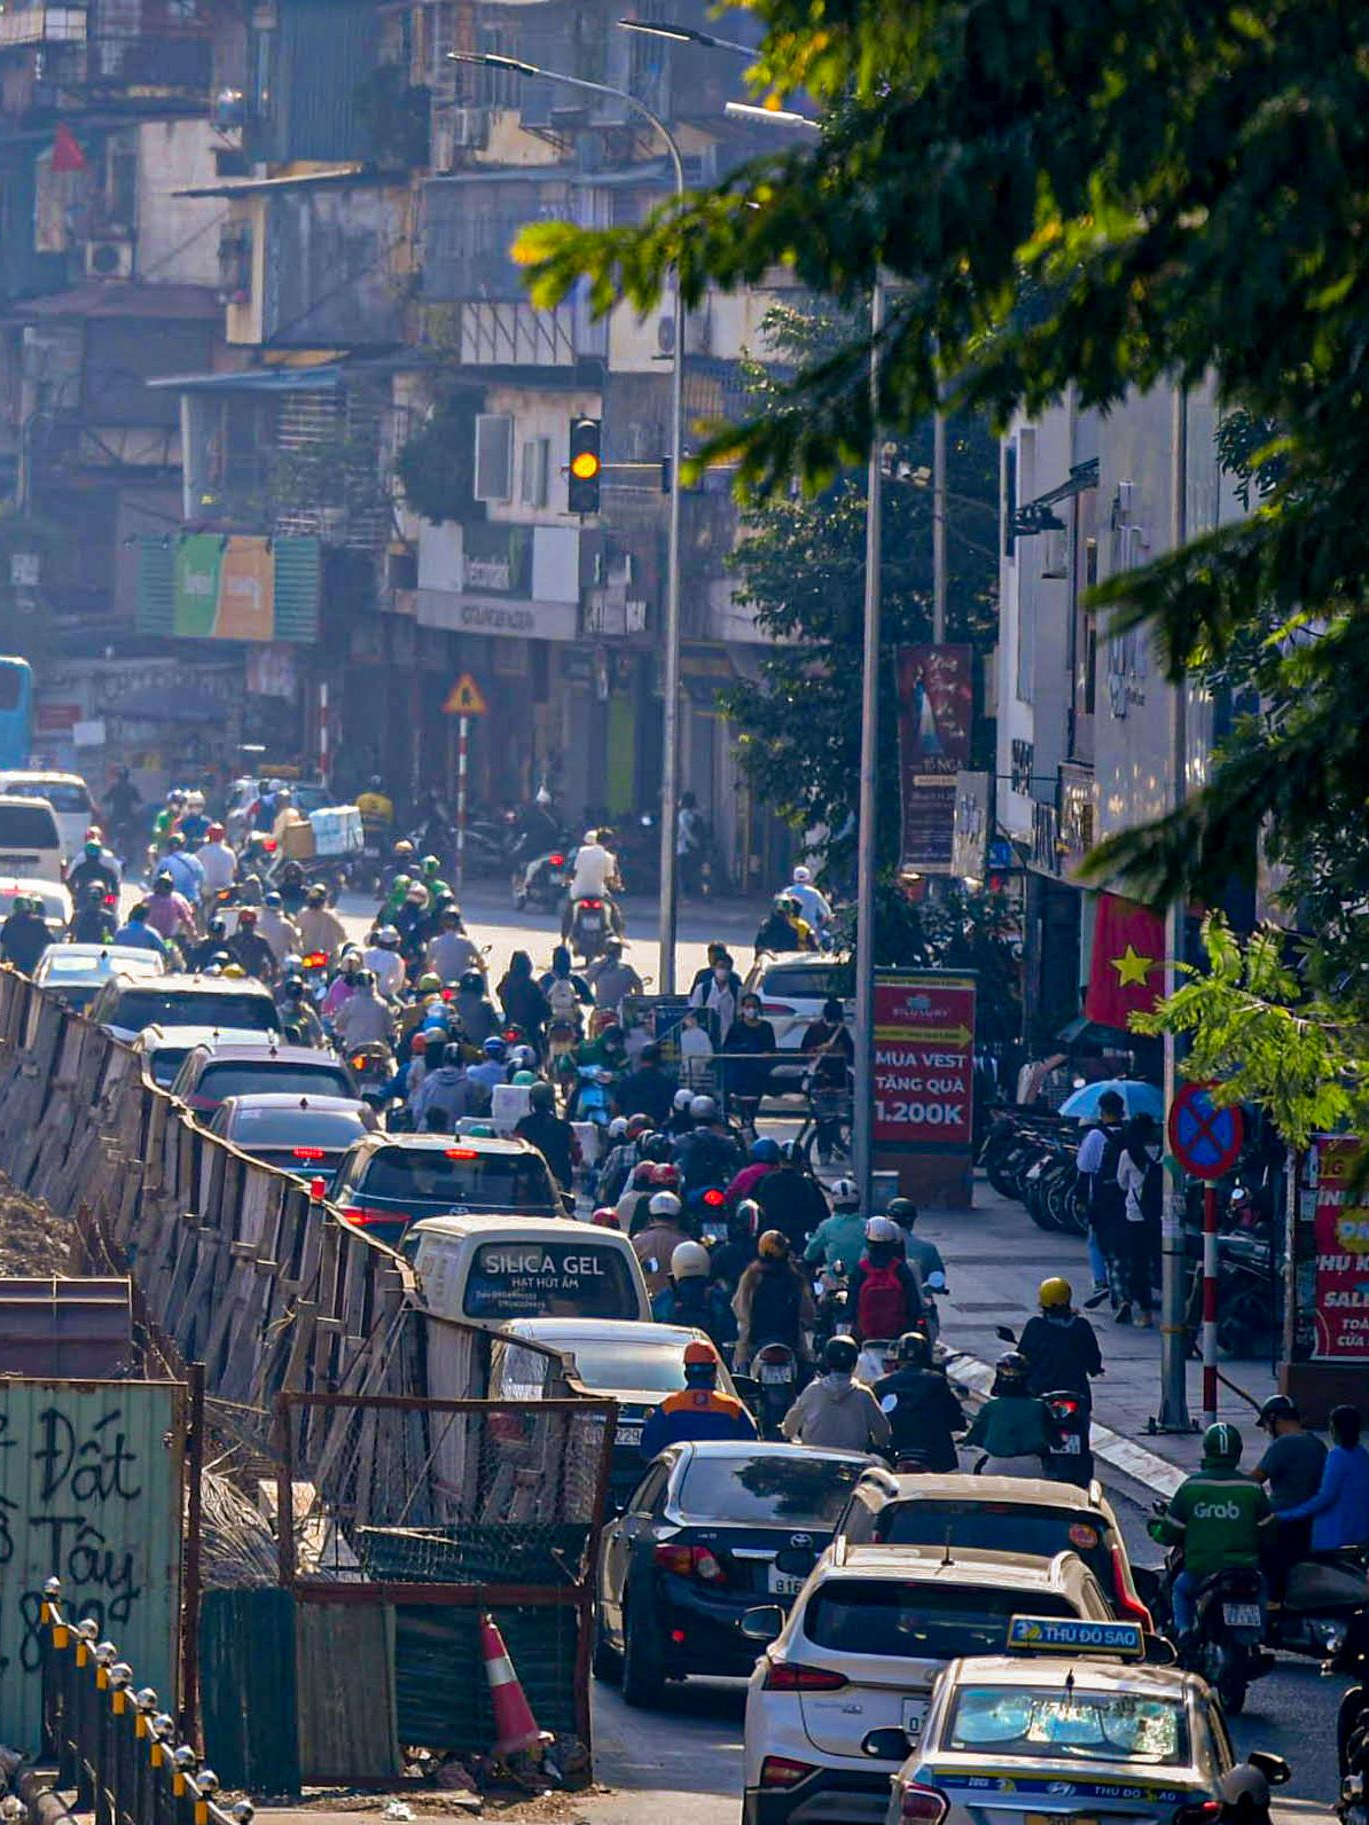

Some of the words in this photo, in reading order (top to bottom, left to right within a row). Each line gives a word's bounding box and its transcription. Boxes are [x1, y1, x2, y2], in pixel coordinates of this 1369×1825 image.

[875, 1051, 917, 1066] MUA
[921, 1053, 968, 1068] VEST
[875, 1074, 923, 1093] TẶNG
[926, 1076, 965, 1095] QUÀ
[874, 1101, 964, 1124] 1.200K
[485, 1254, 556, 1275] SILICA
[562, 1255, 605, 1276] GEL
[1316, 1254, 1351, 1276] HỤ
[33, 1408, 142, 1502] Đất
[1194, 1500, 1240, 1519] Grab
[29, 1515, 141, 1624] Tây
[1078, 1626, 1102, 1644] ĐÔ
[1104, 1630, 1136, 1647] SAO
